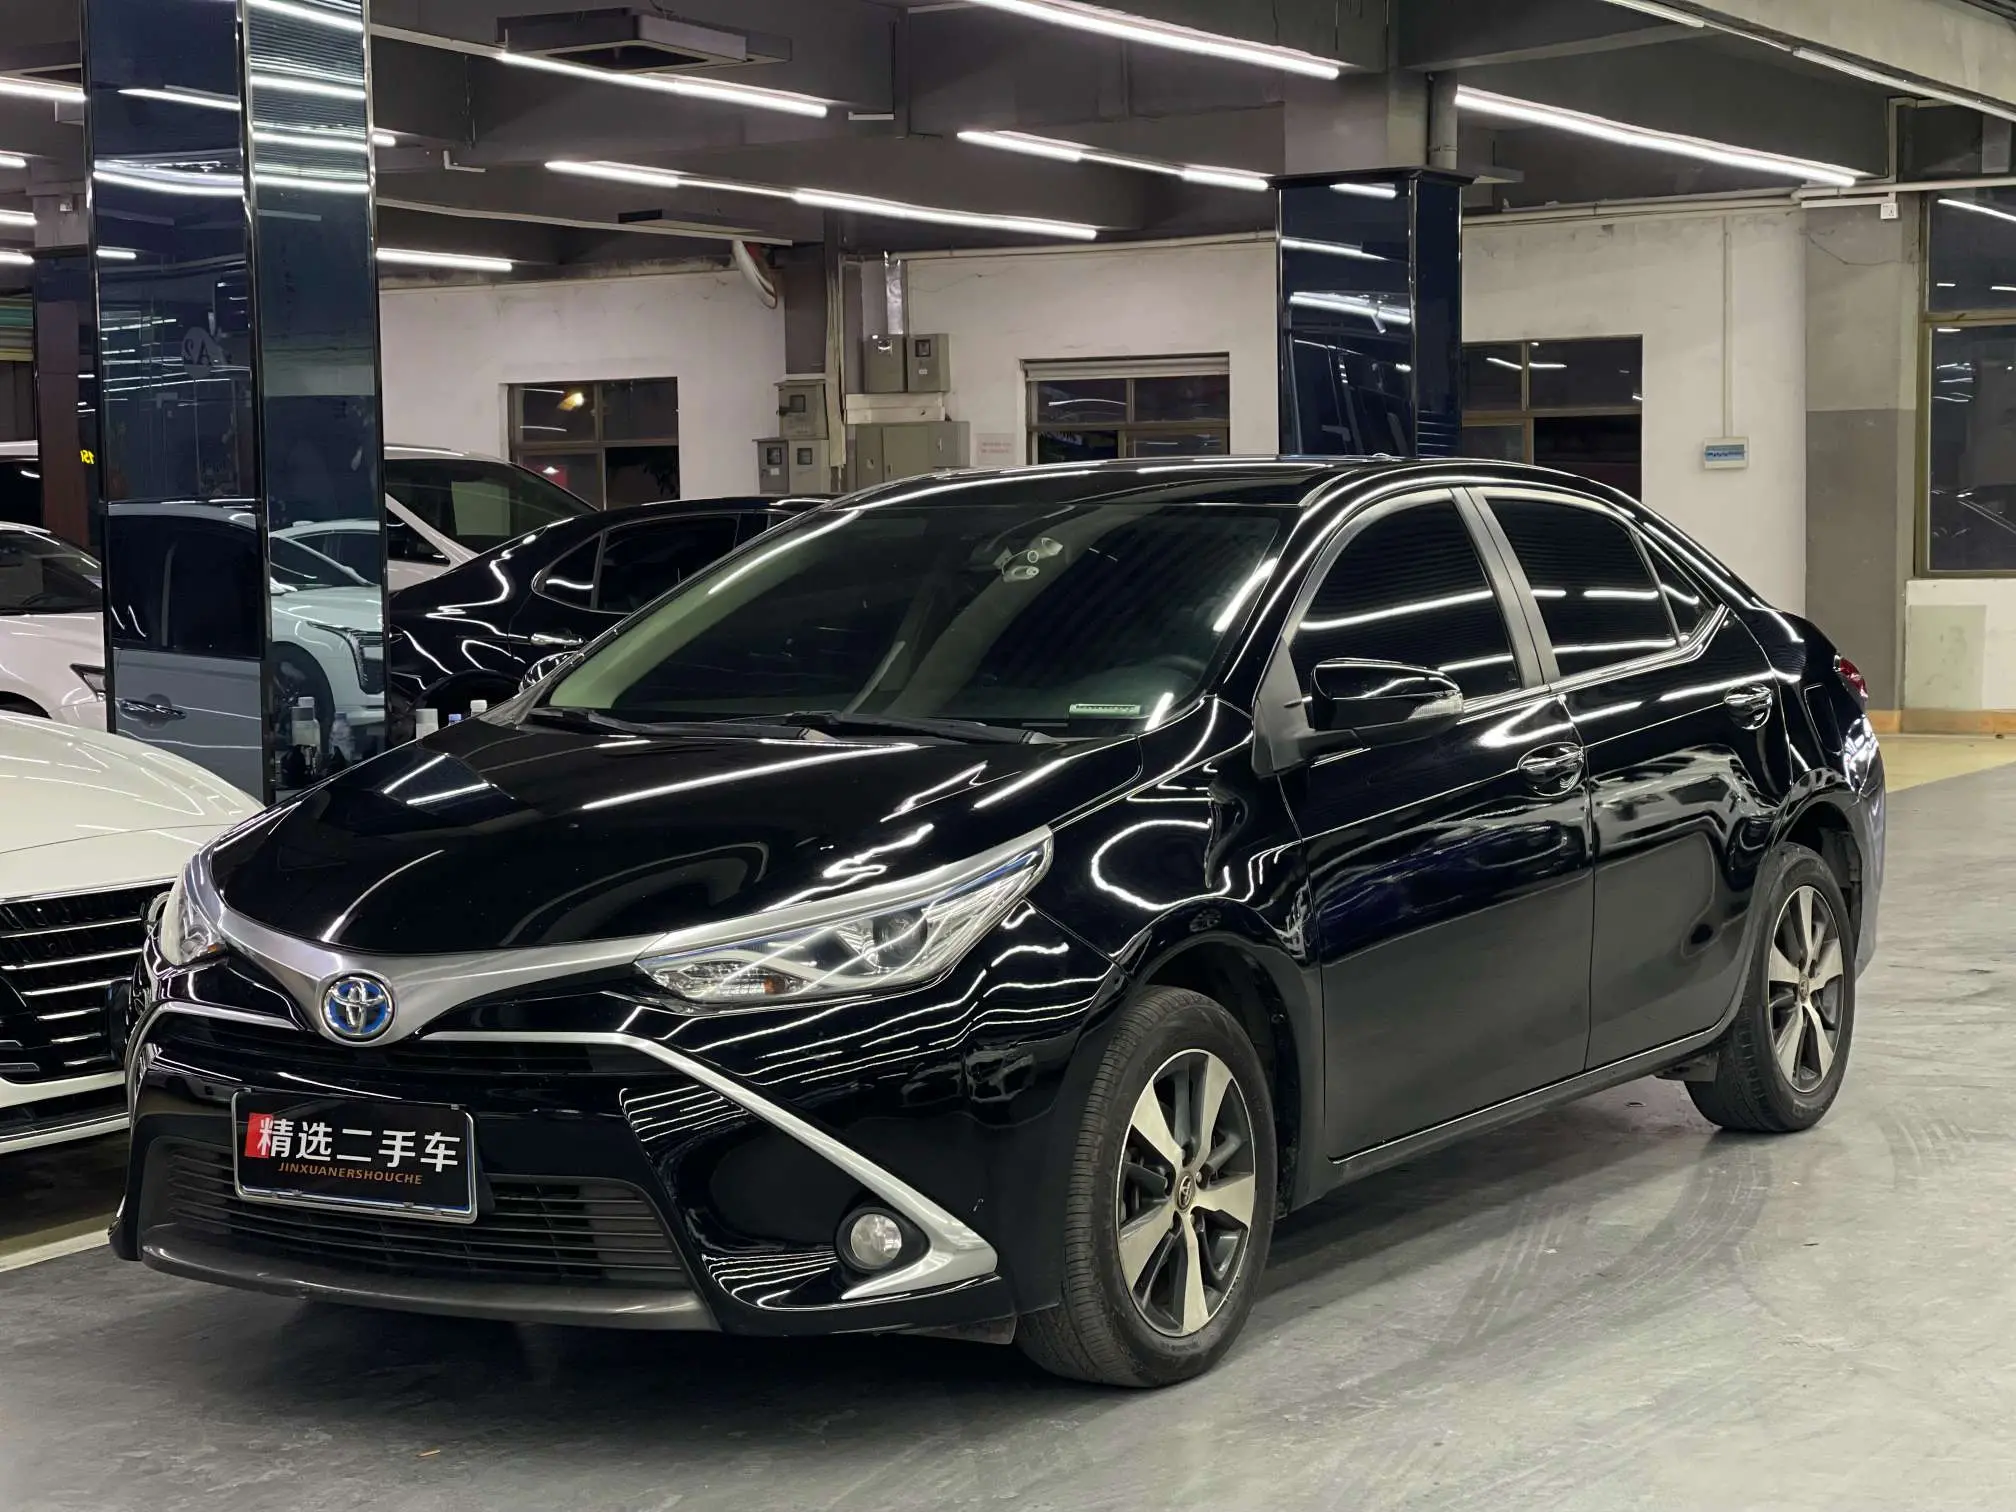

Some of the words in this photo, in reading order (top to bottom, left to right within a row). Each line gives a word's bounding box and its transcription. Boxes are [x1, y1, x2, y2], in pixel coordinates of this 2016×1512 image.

[257, 1117, 461, 1173] 精选二手车
[278, 1162, 423, 1185] JINXUANERSHOUCHE
